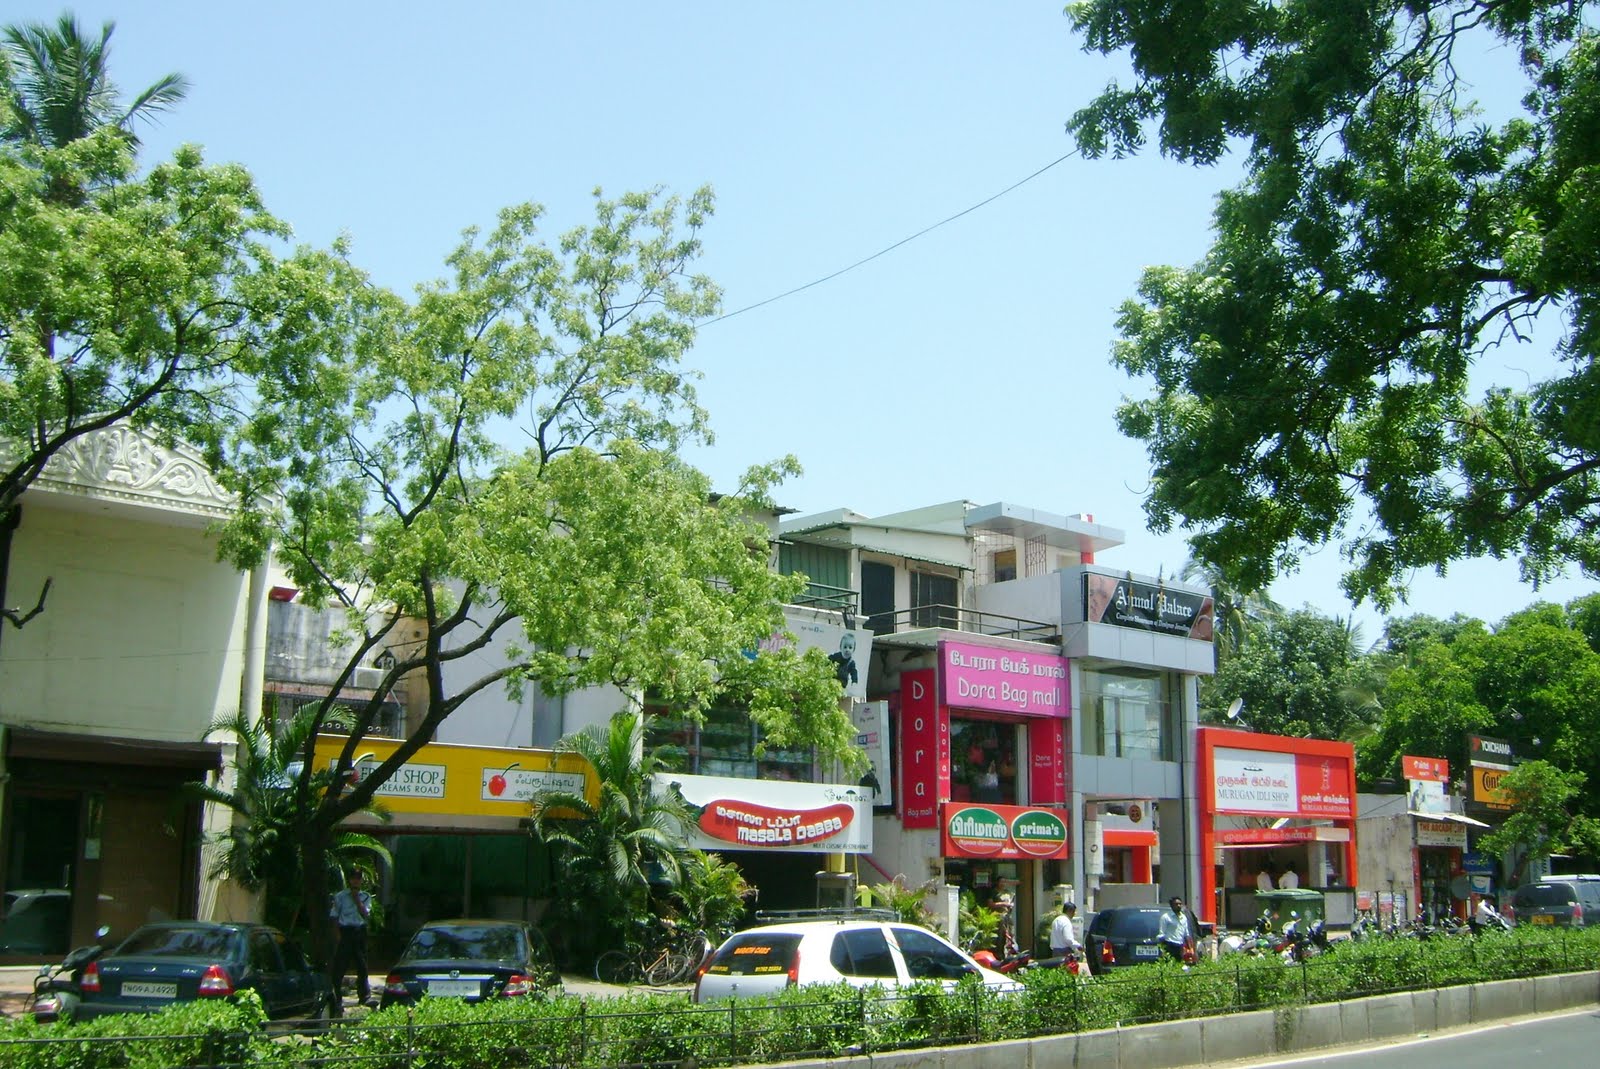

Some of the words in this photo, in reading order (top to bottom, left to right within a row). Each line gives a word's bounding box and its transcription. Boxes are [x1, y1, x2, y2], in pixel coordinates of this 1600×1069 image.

[1157, 593, 1192, 617] Palace
[950, 650, 997, 671] டோரா
[1000, 656, 1030, 675] பேக்
[1034, 662, 1066, 679] மால்
[958, 677, 996, 700] Dora
[1001, 682, 1028, 708] Bag
[1032, 687, 1060, 706] mall
[912, 681, 924, 796] Dora
[1480, 739, 1511, 755] YOKOHAMA
[404, 770, 440, 784] SHOP
[1217, 773, 1248, 787] முருகன்
[415, 785, 440, 794] ROAD
[1218, 789, 1255, 800] MURUGAN
[1256, 791, 1270, 801] IDLI
[1272, 792, 1290, 803] SHOP
[716, 806, 764, 826] மசாலா
[767, 814, 802, 828] டப்பா
[1020, 822, 1060, 836] prima's
